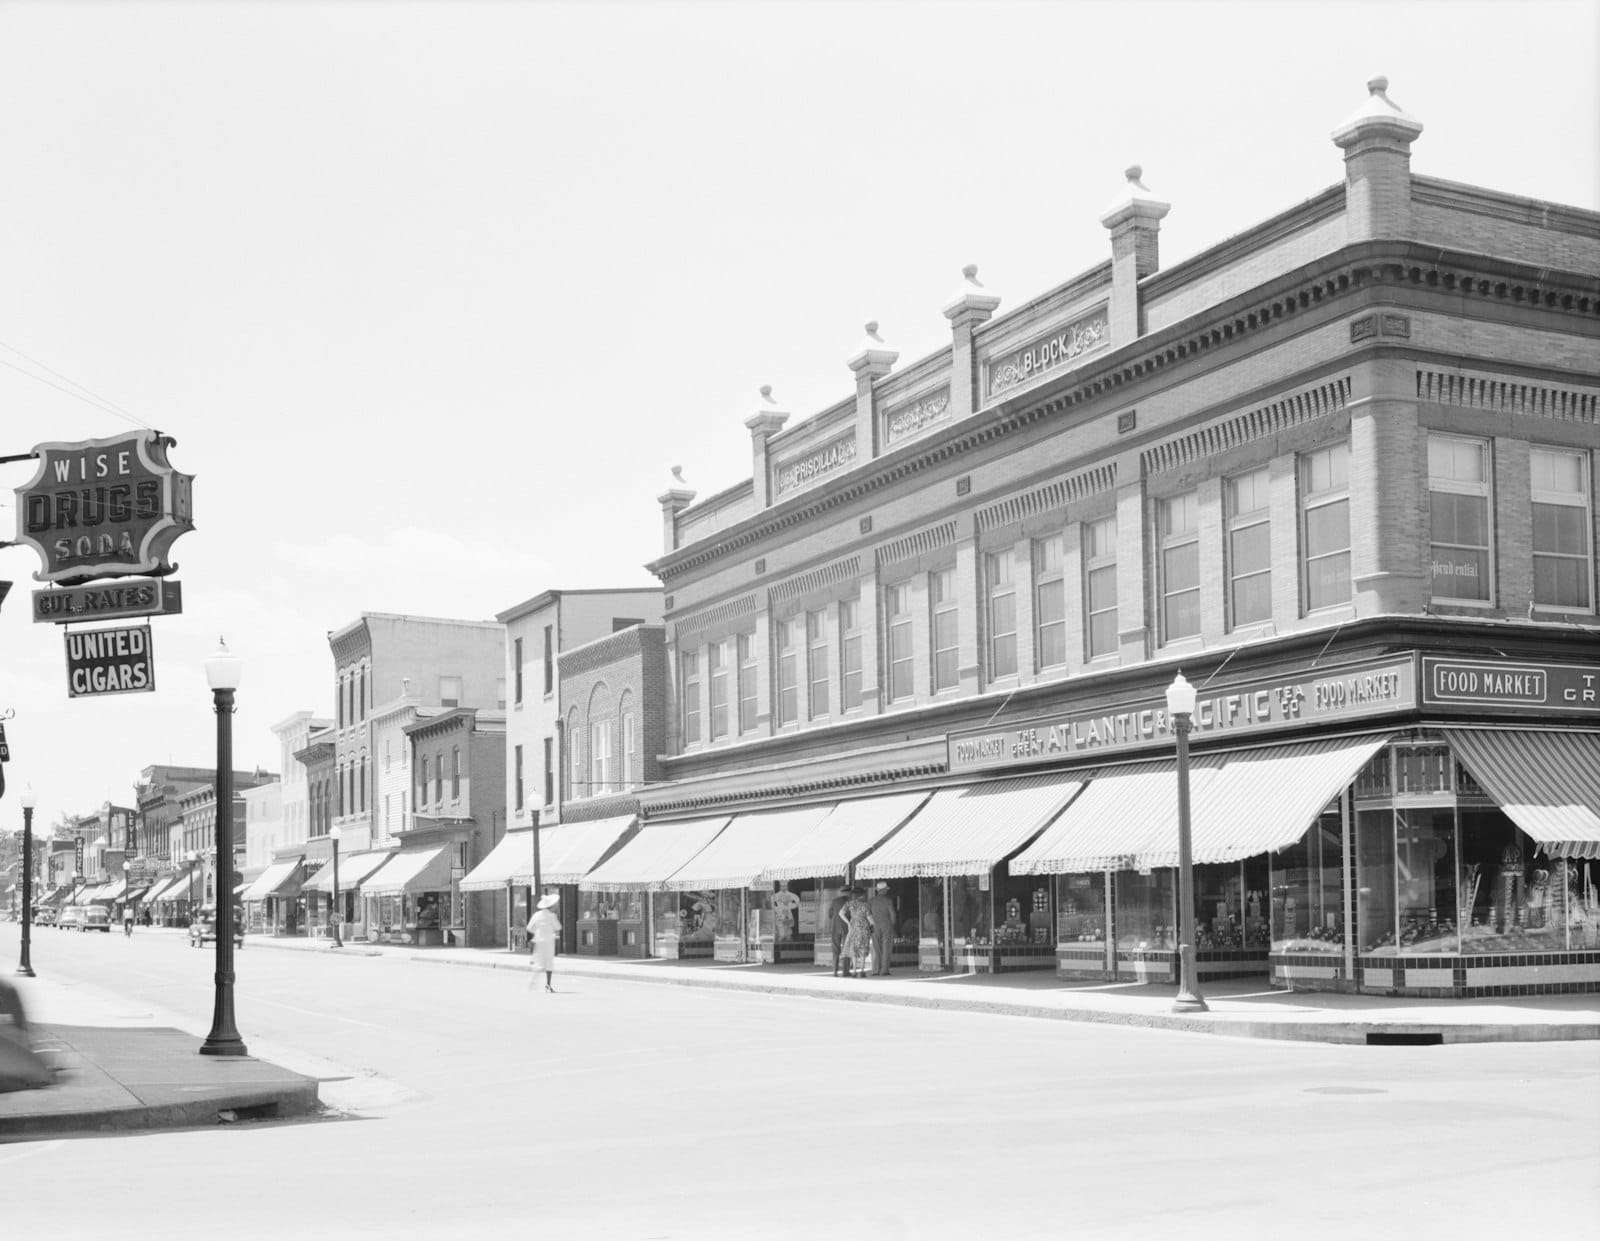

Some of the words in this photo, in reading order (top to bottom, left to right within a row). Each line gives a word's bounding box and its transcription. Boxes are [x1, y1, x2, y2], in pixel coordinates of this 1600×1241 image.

[1024, 334, 1067, 372] BLOCK
[54, 451, 130, 482] WISE
[795, 447, 840, 480] PRISCILLA
[28, 481, 159, 533] DRUGS
[55, 531, 135, 560] SODA
[84, 586, 154, 610] RATES
[70, 629, 143, 660] UNITED
[73, 662, 147, 694] CIGARS
[1275, 685, 1304, 702] TEA
[1315, 681, 1345, 707] FOOD
[1348, 672, 1398, 703] MARKET
[1440, 671, 1478, 692] FOOD
[1483, 673, 1541, 695] MARKET
[1016, 728, 1036, 742] THE
[1048, 710, 1152, 748] ATLANTIC
[1157, 710, 1166, 729] &
[1012, 739, 1043, 756] GREAT
